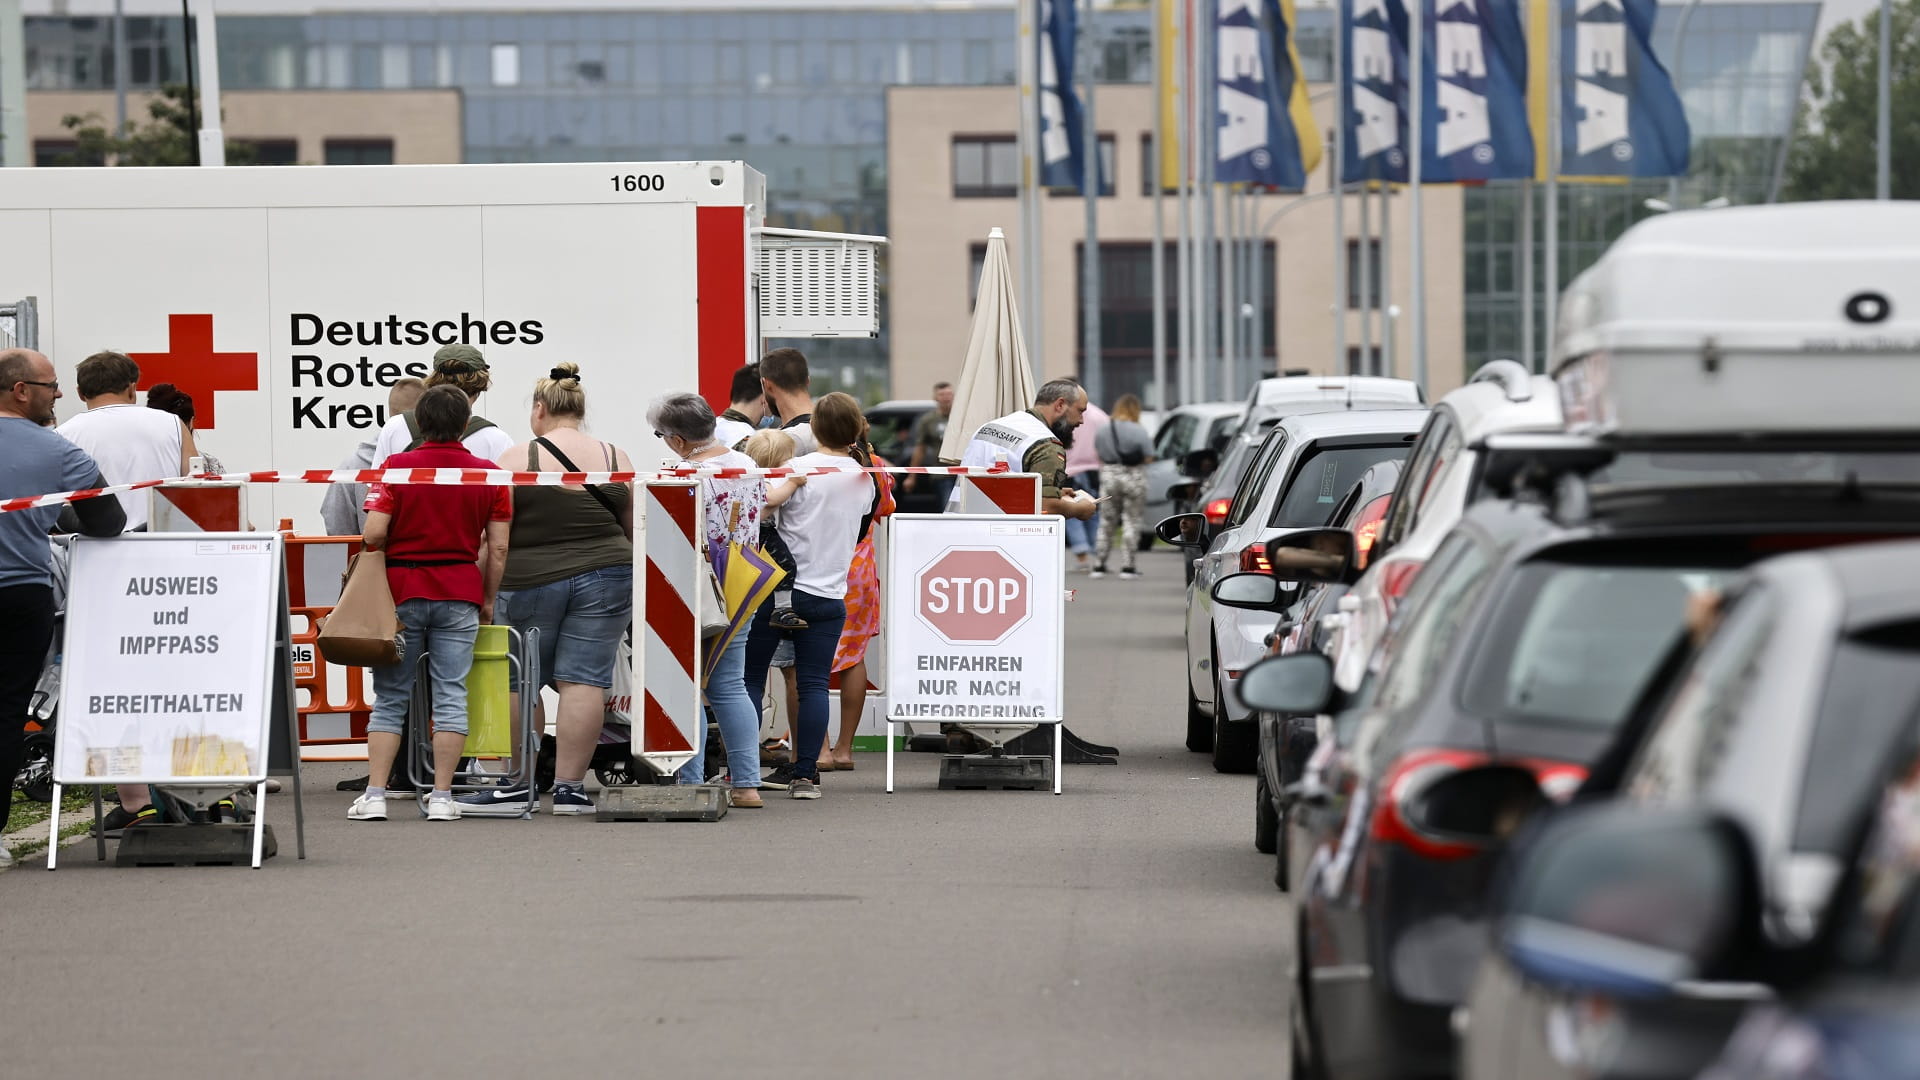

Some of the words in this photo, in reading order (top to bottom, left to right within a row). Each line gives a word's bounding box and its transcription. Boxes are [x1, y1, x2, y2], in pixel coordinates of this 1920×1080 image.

[610, 174, 665, 192] 1600
[290, 312, 545, 346] Deutsches
[291, 355, 428, 388] Rotes
[126, 576, 218, 596] AUSWEIS
[927, 577, 1020, 614] STOP
[153, 606, 189, 625] und
[119, 635, 219, 655] IMPFPASS
[917, 655, 1023, 672] EINFAHREN
[918, 680, 958, 696] NUR
[969, 680, 1021, 697] NACH
[88, 693, 243, 714] BEREITHALTEN
[603, 694, 632, 714] H&M
[894, 704, 1046, 718] AUFFORDERUNG
